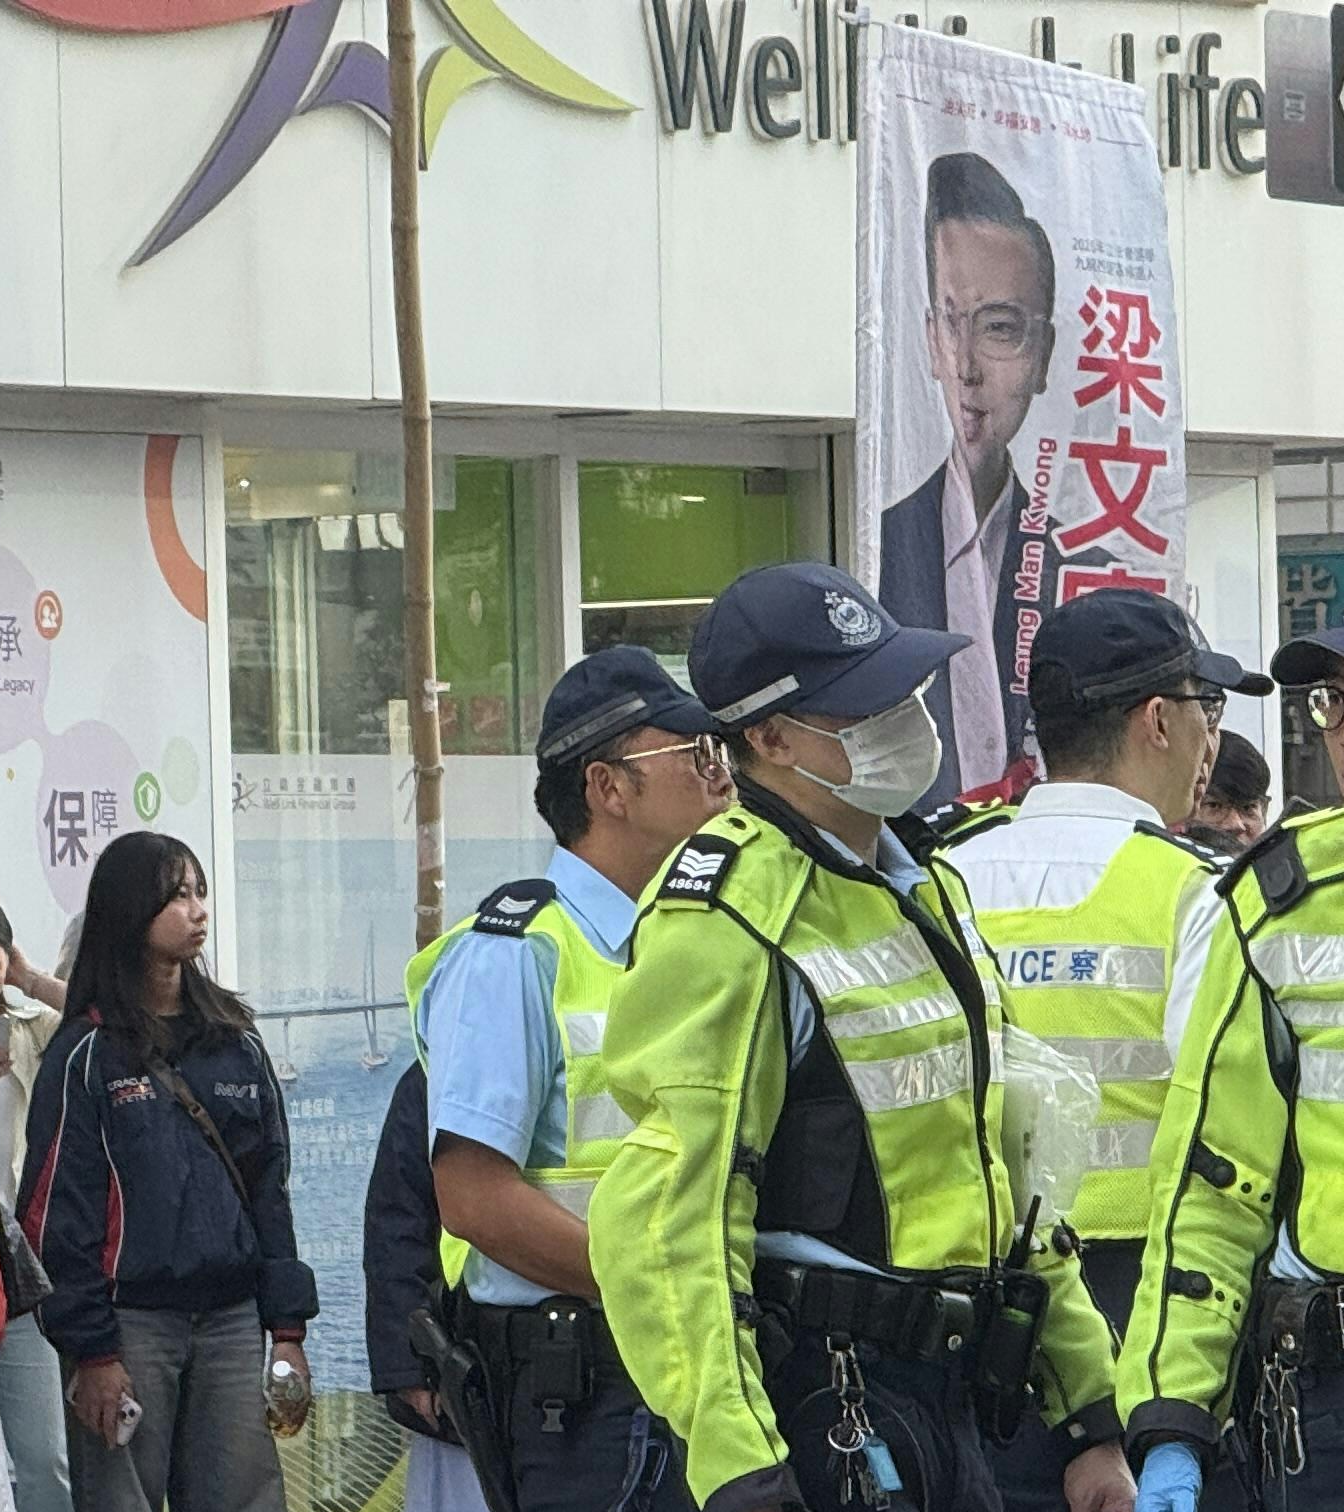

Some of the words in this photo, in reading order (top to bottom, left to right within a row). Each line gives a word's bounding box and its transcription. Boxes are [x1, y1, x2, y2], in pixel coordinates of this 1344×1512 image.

[1055, 284, 1167, 606] 梁文
[1020, 438, 1058, 534] Kwong
[1016, 541, 1044, 603] Man
[43, 788, 119, 868] 保障
[1008, 950, 1057, 983] ICE
[1070, 949, 1099, 981] 察
